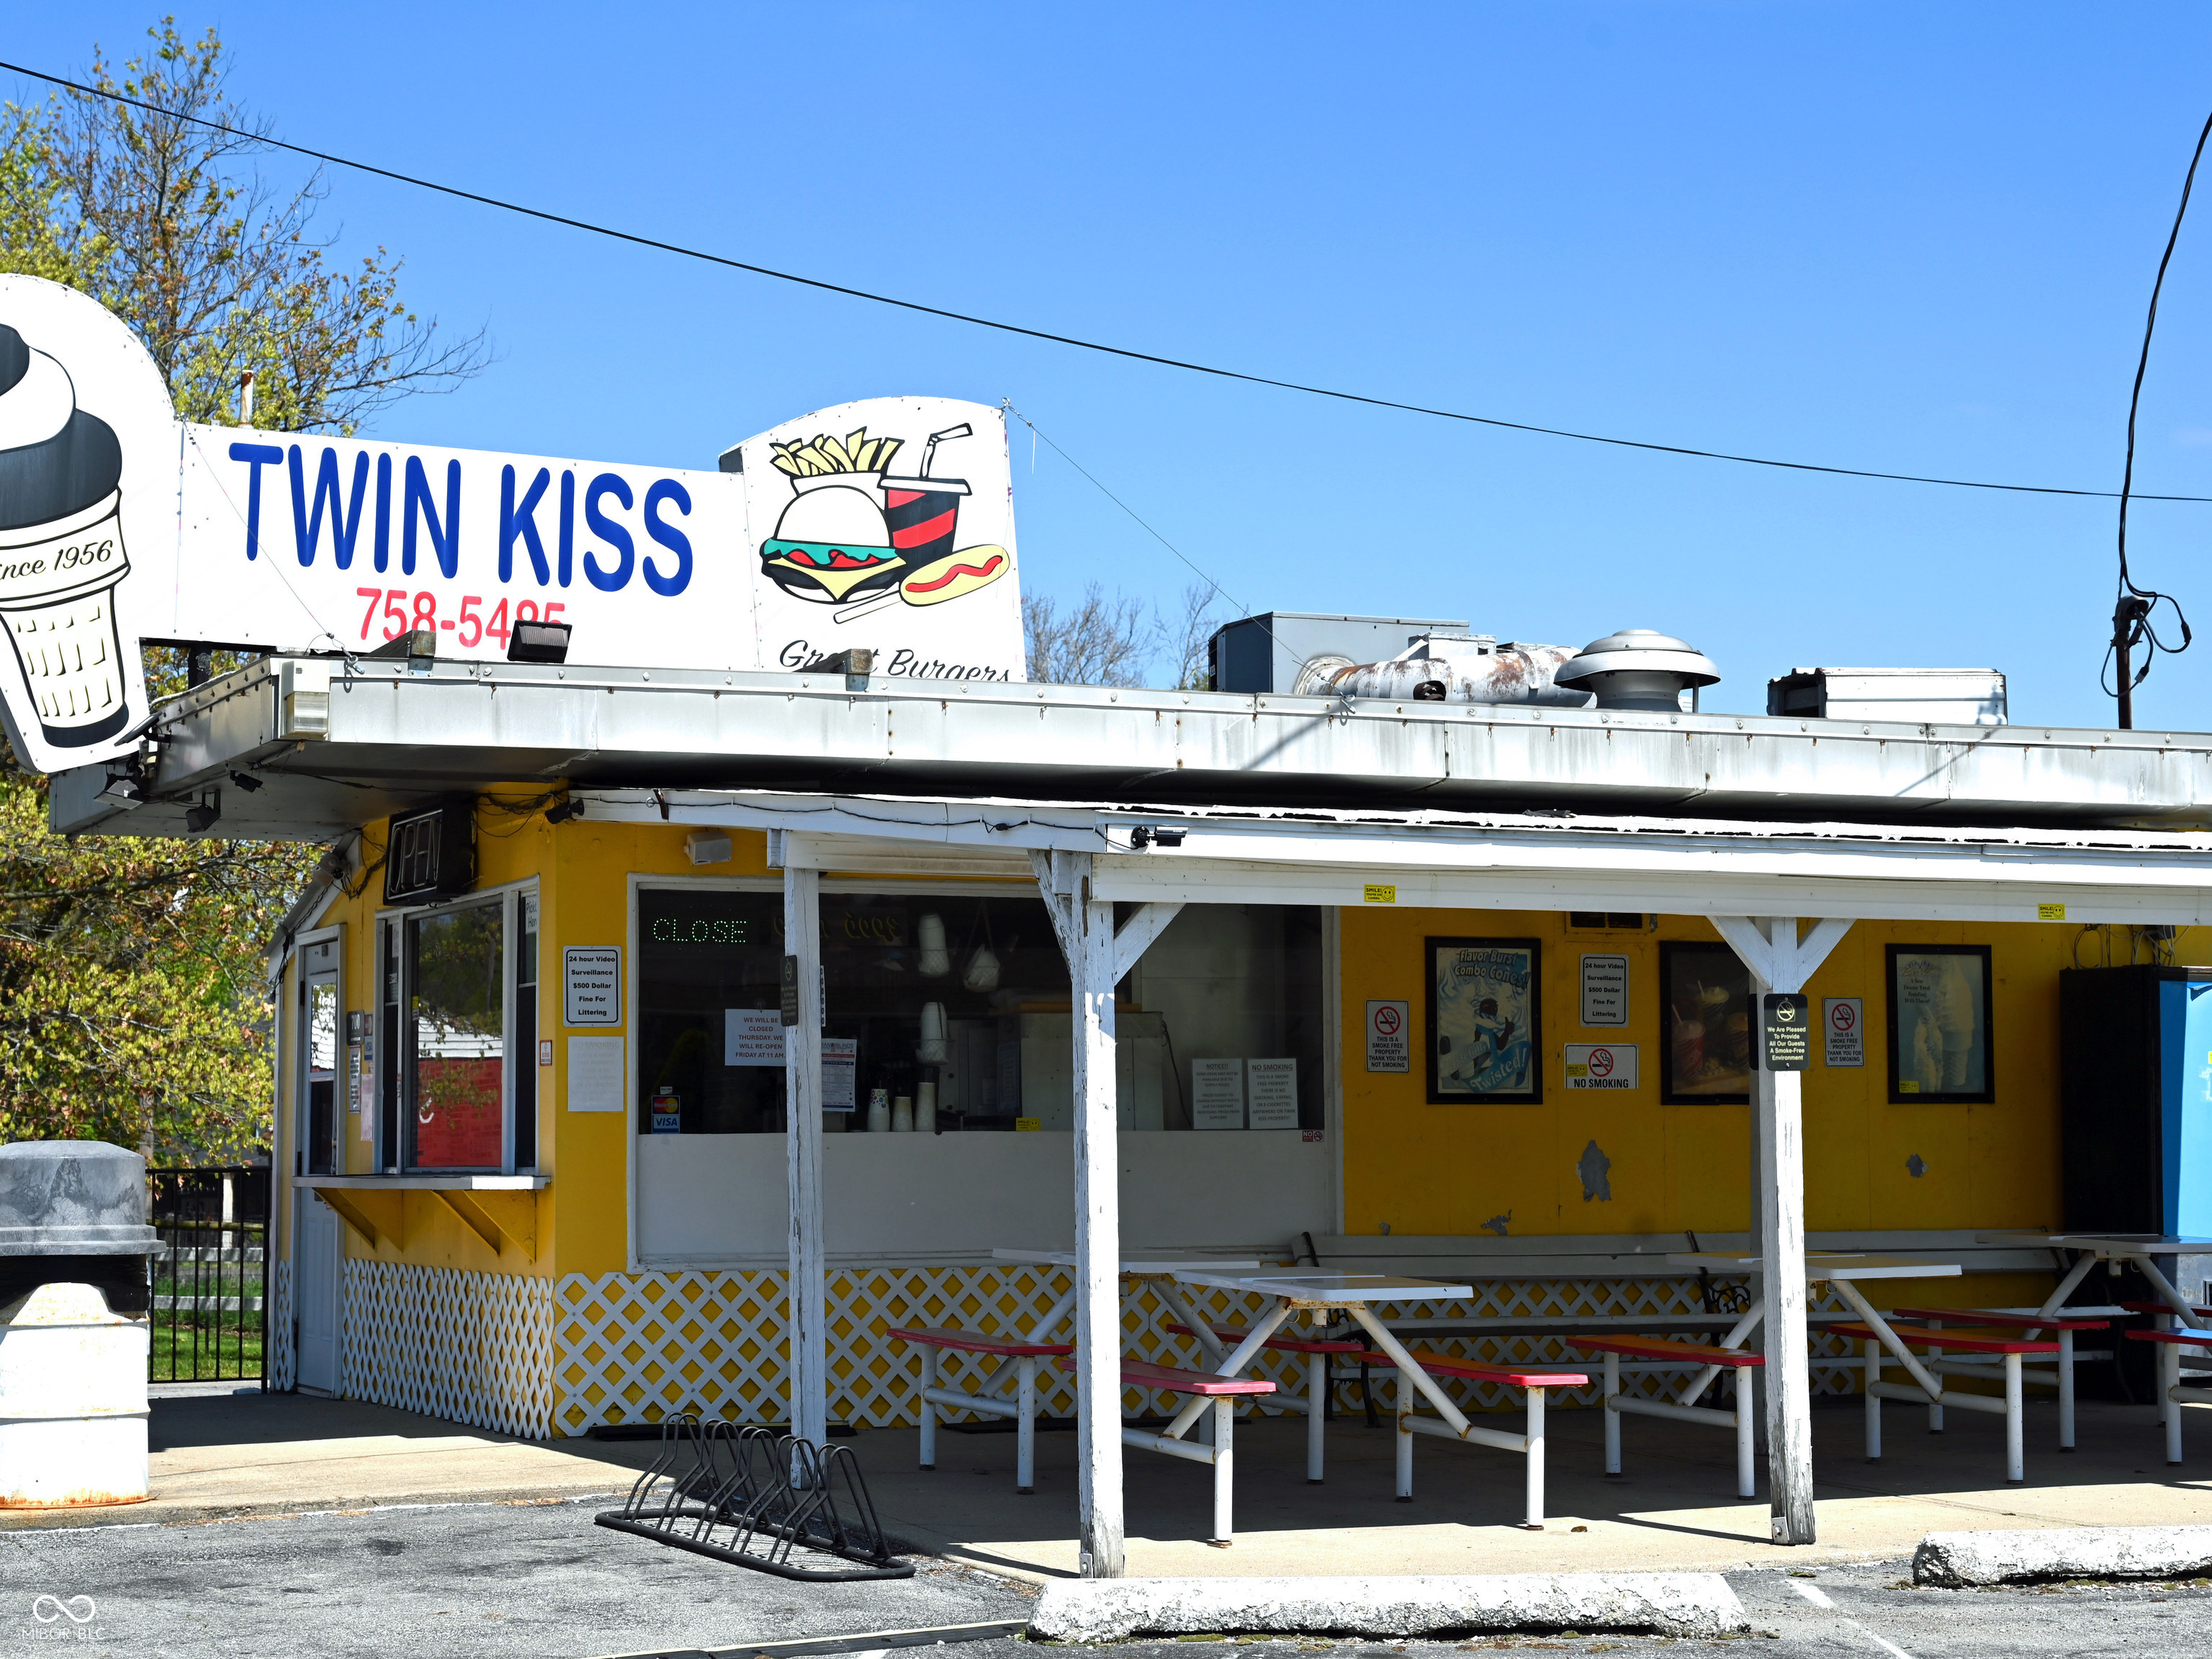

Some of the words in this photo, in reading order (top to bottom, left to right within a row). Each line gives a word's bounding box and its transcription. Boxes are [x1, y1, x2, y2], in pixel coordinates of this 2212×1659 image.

[228, 442, 462, 579] TWIN
[498, 464, 693, 596] KISS
[0, 560, 46, 580] nce
[54, 540, 113, 570] 1956
[390, 819, 442, 893] OPEN
[652, 918, 747, 943] CLOSE
[1459, 948, 1488, 963] Flavor
[1490, 949, 1518, 966] Burst
[1489, 966, 1531, 990] Cones!
[1470, 1048, 1527, 1091] Twisted!
[1574, 1079, 1586, 1088] NO
[1588, 1079, 1629, 1089] SMOKING
[656, 1117, 678, 1126] VISA
